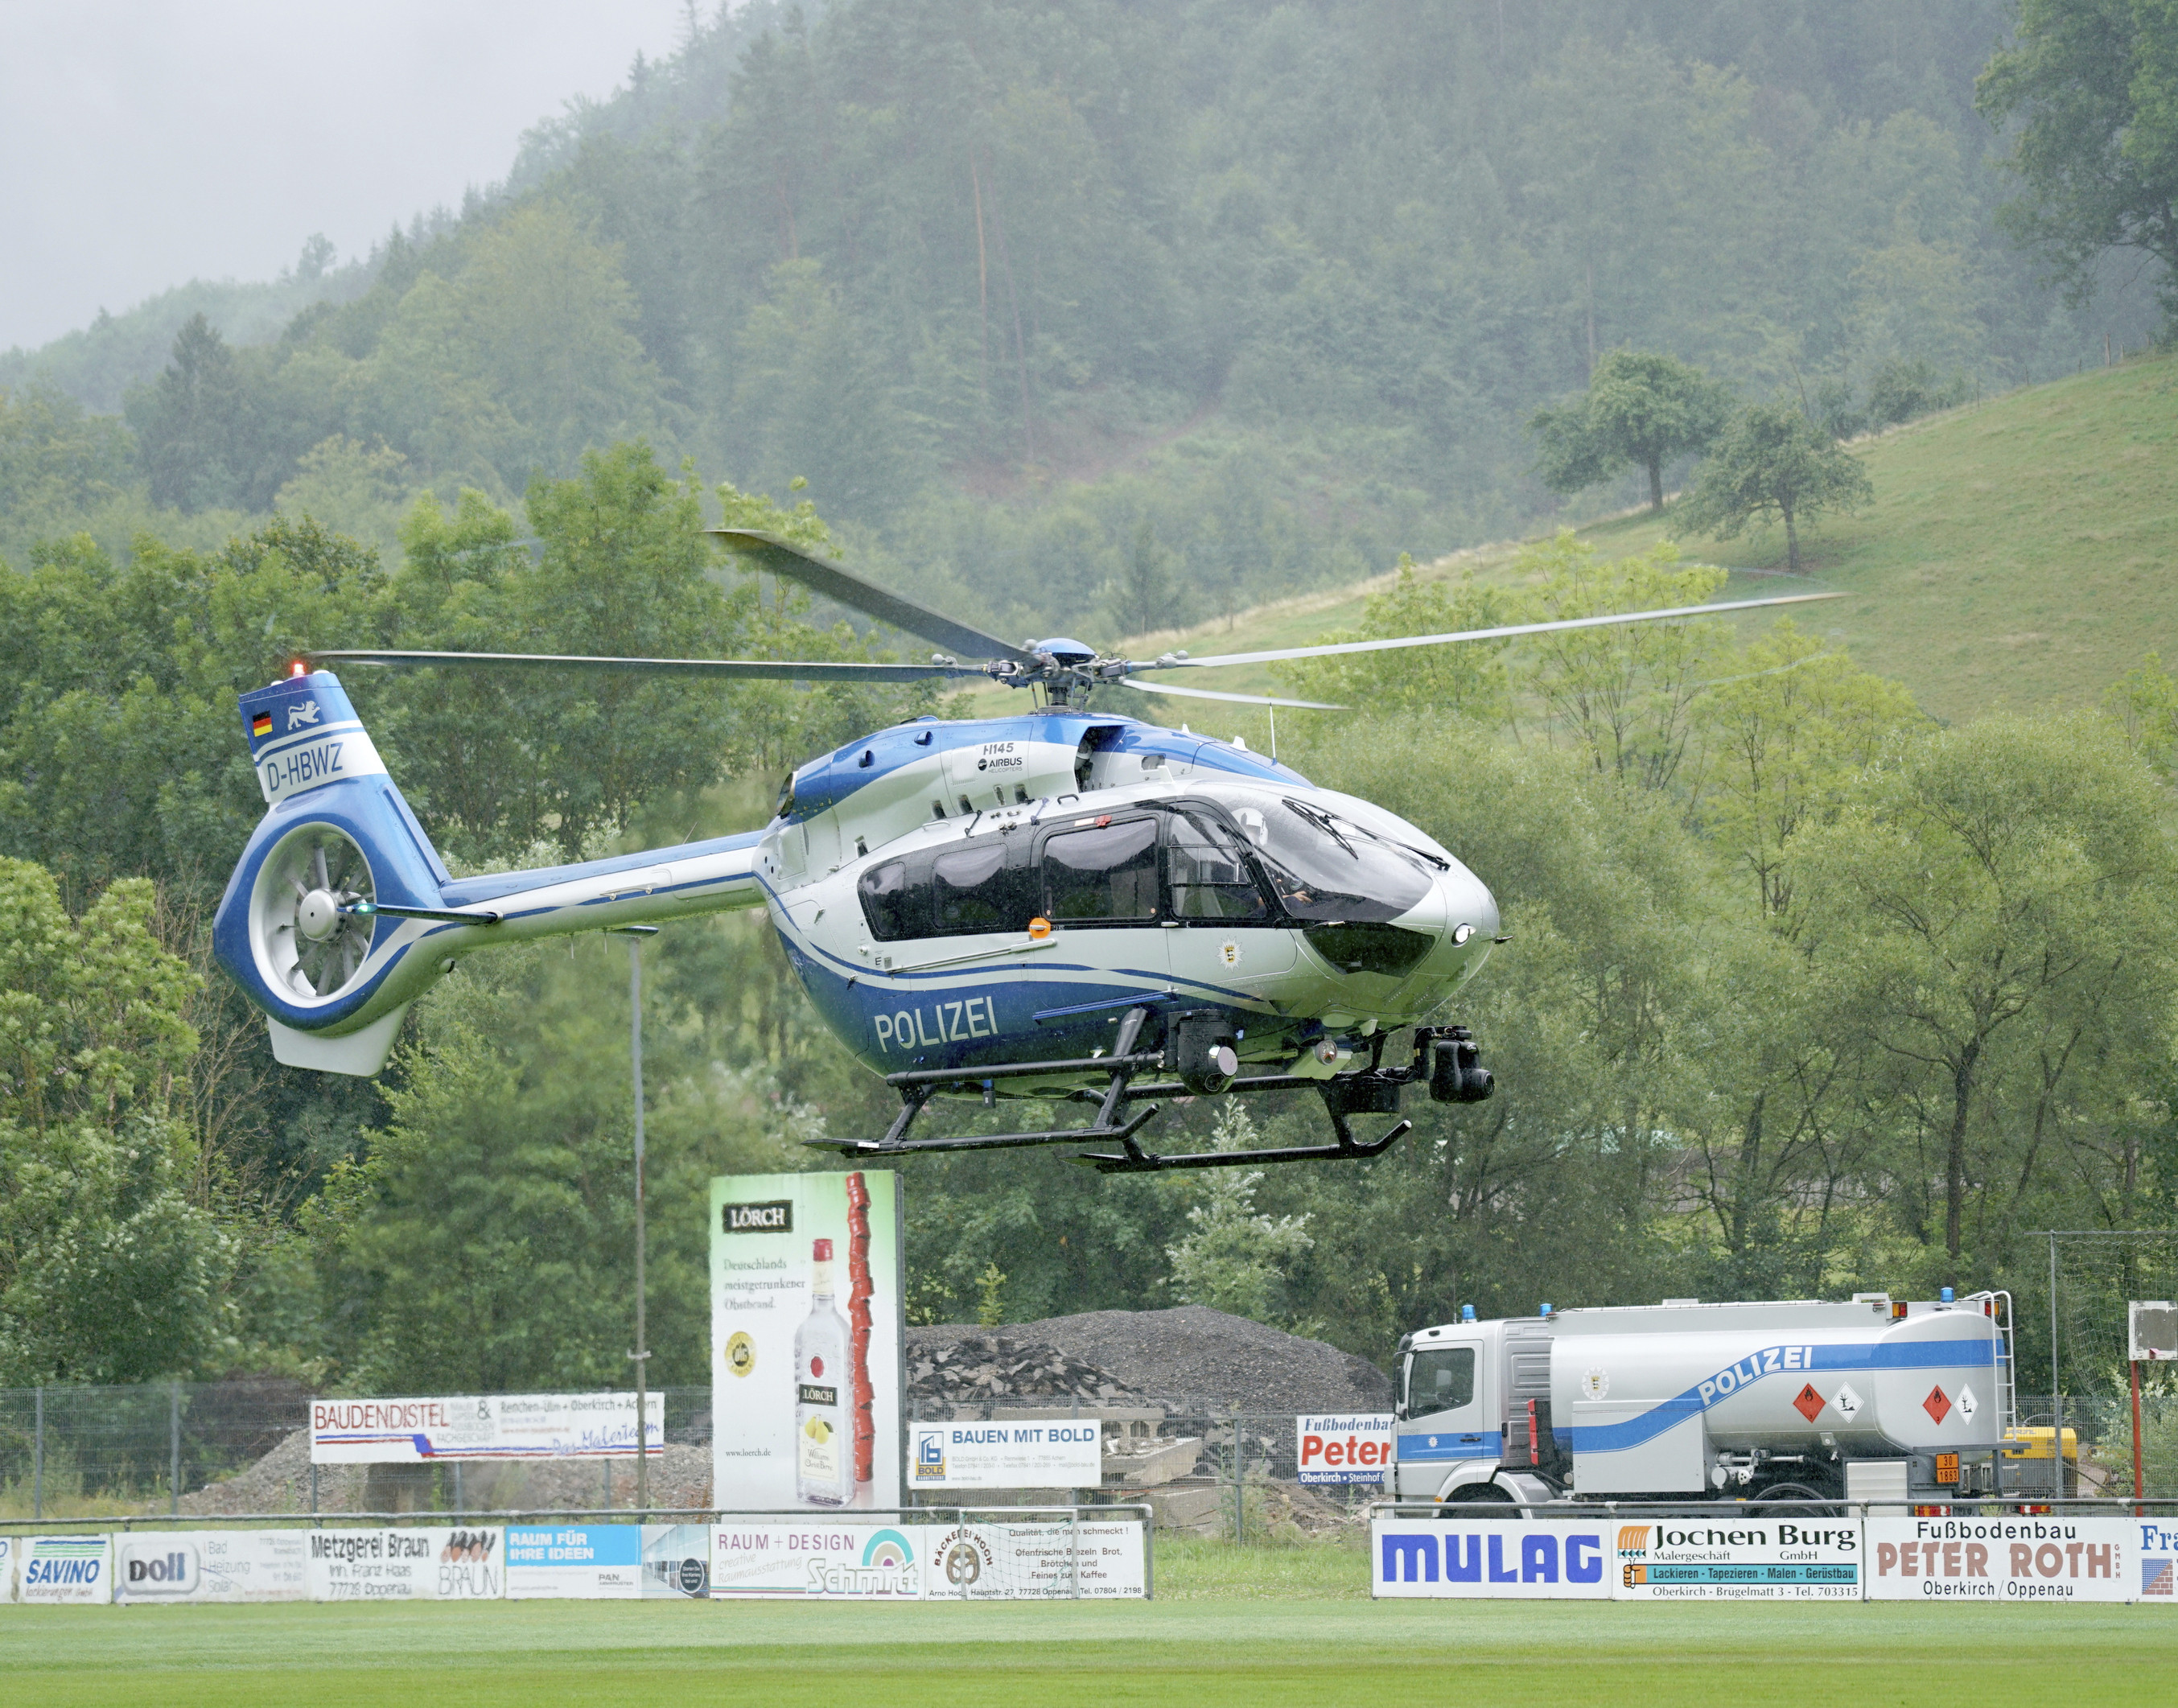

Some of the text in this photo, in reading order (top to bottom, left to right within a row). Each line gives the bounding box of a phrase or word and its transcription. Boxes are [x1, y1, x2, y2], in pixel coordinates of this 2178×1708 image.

[982, 742, 1015, 755] H145
[266, 741, 344, 792] D-HBWZ
[989, 756, 1023, 768] AIRBUS
[987, 766, 1023, 774] HELICOPTERS
[874, 995, 999, 1053] POLIZEI
[731, 1206, 785, 1228] LÖRCH
[723, 1257, 787, 1271] Deutschlands
[1698, 1346, 1813, 1406] POLIZEI
[804, 1387, 834, 1402] LÖRCH
[570, 1398, 616, 1411] Oberkirch
[315, 1403, 451, 1430] BAUDENDISTEL
[952, 1428, 1095, 1444] BAUEN MIT BOLD
[725, 1447, 772, 1457] www.loerch.de
[1301, 1435, 1391, 1466] Peter
[1943, 1455, 1954, 1466] 30
[918, 1467, 944, 1475] BOLD
[1300, 1473, 1341, 1483] Oberkirch
[1348, 1472, 1381, 1484] Steinhof
[1940, 1470, 1958, 1481] 1863
[509, 1529, 588, 1546] RAUM FÜR
[1009, 1528, 1044, 1537] Qualität,
[1083, 1527, 1124, 1536] schmeckt
[1917, 1521, 2077, 1539] Fußbodenbau
[718, 1534, 769, 1550] RAUM
[788, 1534, 855, 1551] DESIGN
[1653, 1525, 1857, 1551] Jochen Burg
[208, 1541, 227, 1554] Bad
[311, 1532, 430, 1562] Metzgerei Braun
[509, 1547, 595, 1561] IHRE IDEEN
[974, 1529, 994, 1566] HOCH
[1015, 1547, 1123, 1557] Ofenfrische Bezeln Brot,
[718, 1552, 757, 1570] creative
[1081, 1559, 1098, 1567] und
[1381, 1534, 1603, 1583] MULAG
[1653, 1550, 1818, 1562] Malergeschäft GmbH
[1876, 1541, 2112, 1578] PETER ROTH
[26, 1558, 101, 1584] SAVINO
[130, 1552, 185, 1582] Doll
[208, 1559, 251, 1574] Heizung
[352, 1564, 382, 1577] Franz
[385, 1564, 412, 1577] Haas
[718, 1556, 803, 1584] Raumausstattung
[1653, 1567, 1699, 1579] Lackieren
[1708, 1567, 1759, 1582] Tapezieren
[1767, 1567, 1797, 1579] Malen
[1805, 1566, 1855, 1579] Gerüstbau
[438, 1566, 498, 1595] BRAUN
[598, 1573, 620, 1582] PAN
[806, 1558, 919, 1595] Schmitt
[1031, 1570, 1058, 1579] Feines
[1081, 1570, 1108, 1578] Kaffee
[208, 1579, 232, 1593] Solar
[929, 1589, 946, 1597] Arno
[948, 1588, 962, 1597] Hoc
[970, 1588, 1003, 1597] Hauptstr.
[1019, 1588, 1041, 1596] 77728
[1080, 1587, 1093, 1595] Tel.
[1094, 1587, 1117, 1595] 07804
[1124, 1587, 1142, 1595] 2198
[1653, 1586, 1707, 1597] Oberkirch
[1716, 1586, 1774, 1599] Brügelmatt
[1777, 1587, 1785, 1596] 3
[1794, 1586, 1814, 1597] Tel.
[1818, 1587, 1859, 1597] 703315
[1923, 1581, 1995, 1596] Oberkirch
[2007, 1581, 2074, 1599] Oppenau
